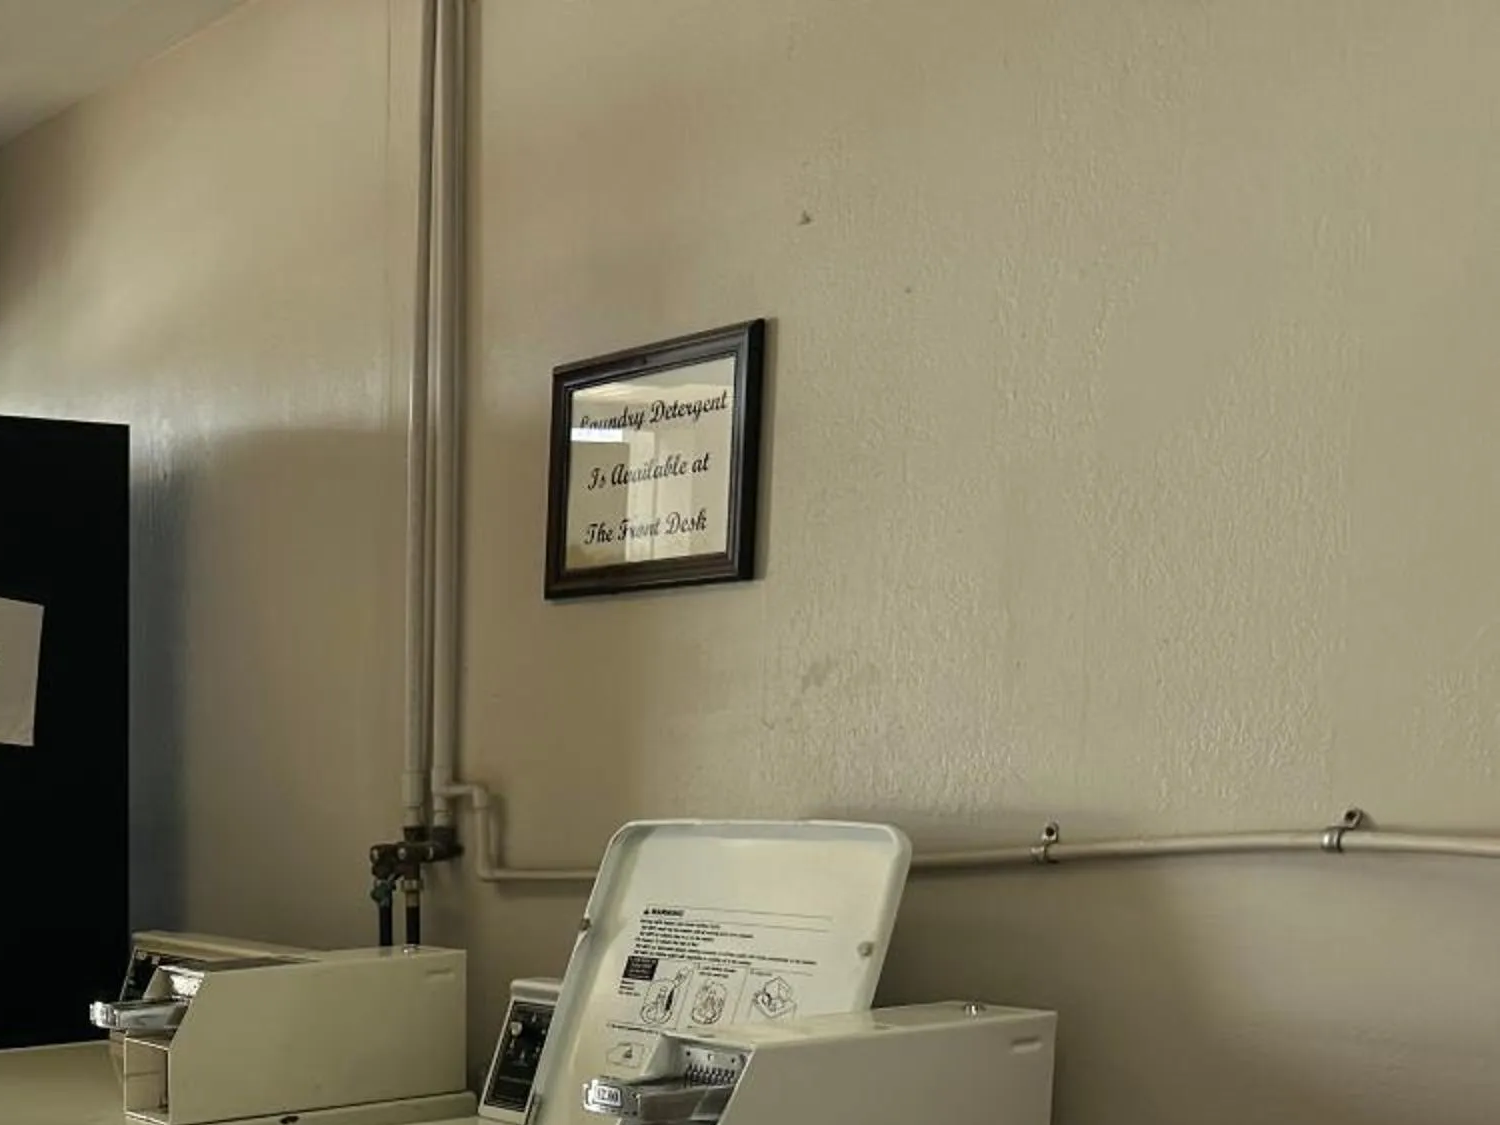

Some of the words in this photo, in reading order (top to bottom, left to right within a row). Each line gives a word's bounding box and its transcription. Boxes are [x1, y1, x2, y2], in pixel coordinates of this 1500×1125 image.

[650, 390, 728, 423] Detergent
[587, 467, 605, 491] Is
[611, 453, 688, 486] Available
[692, 452, 710, 473] at
[584, 520, 614, 545] The
[617, 517, 661, 541] Front
[665, 508, 707, 535] Desk
